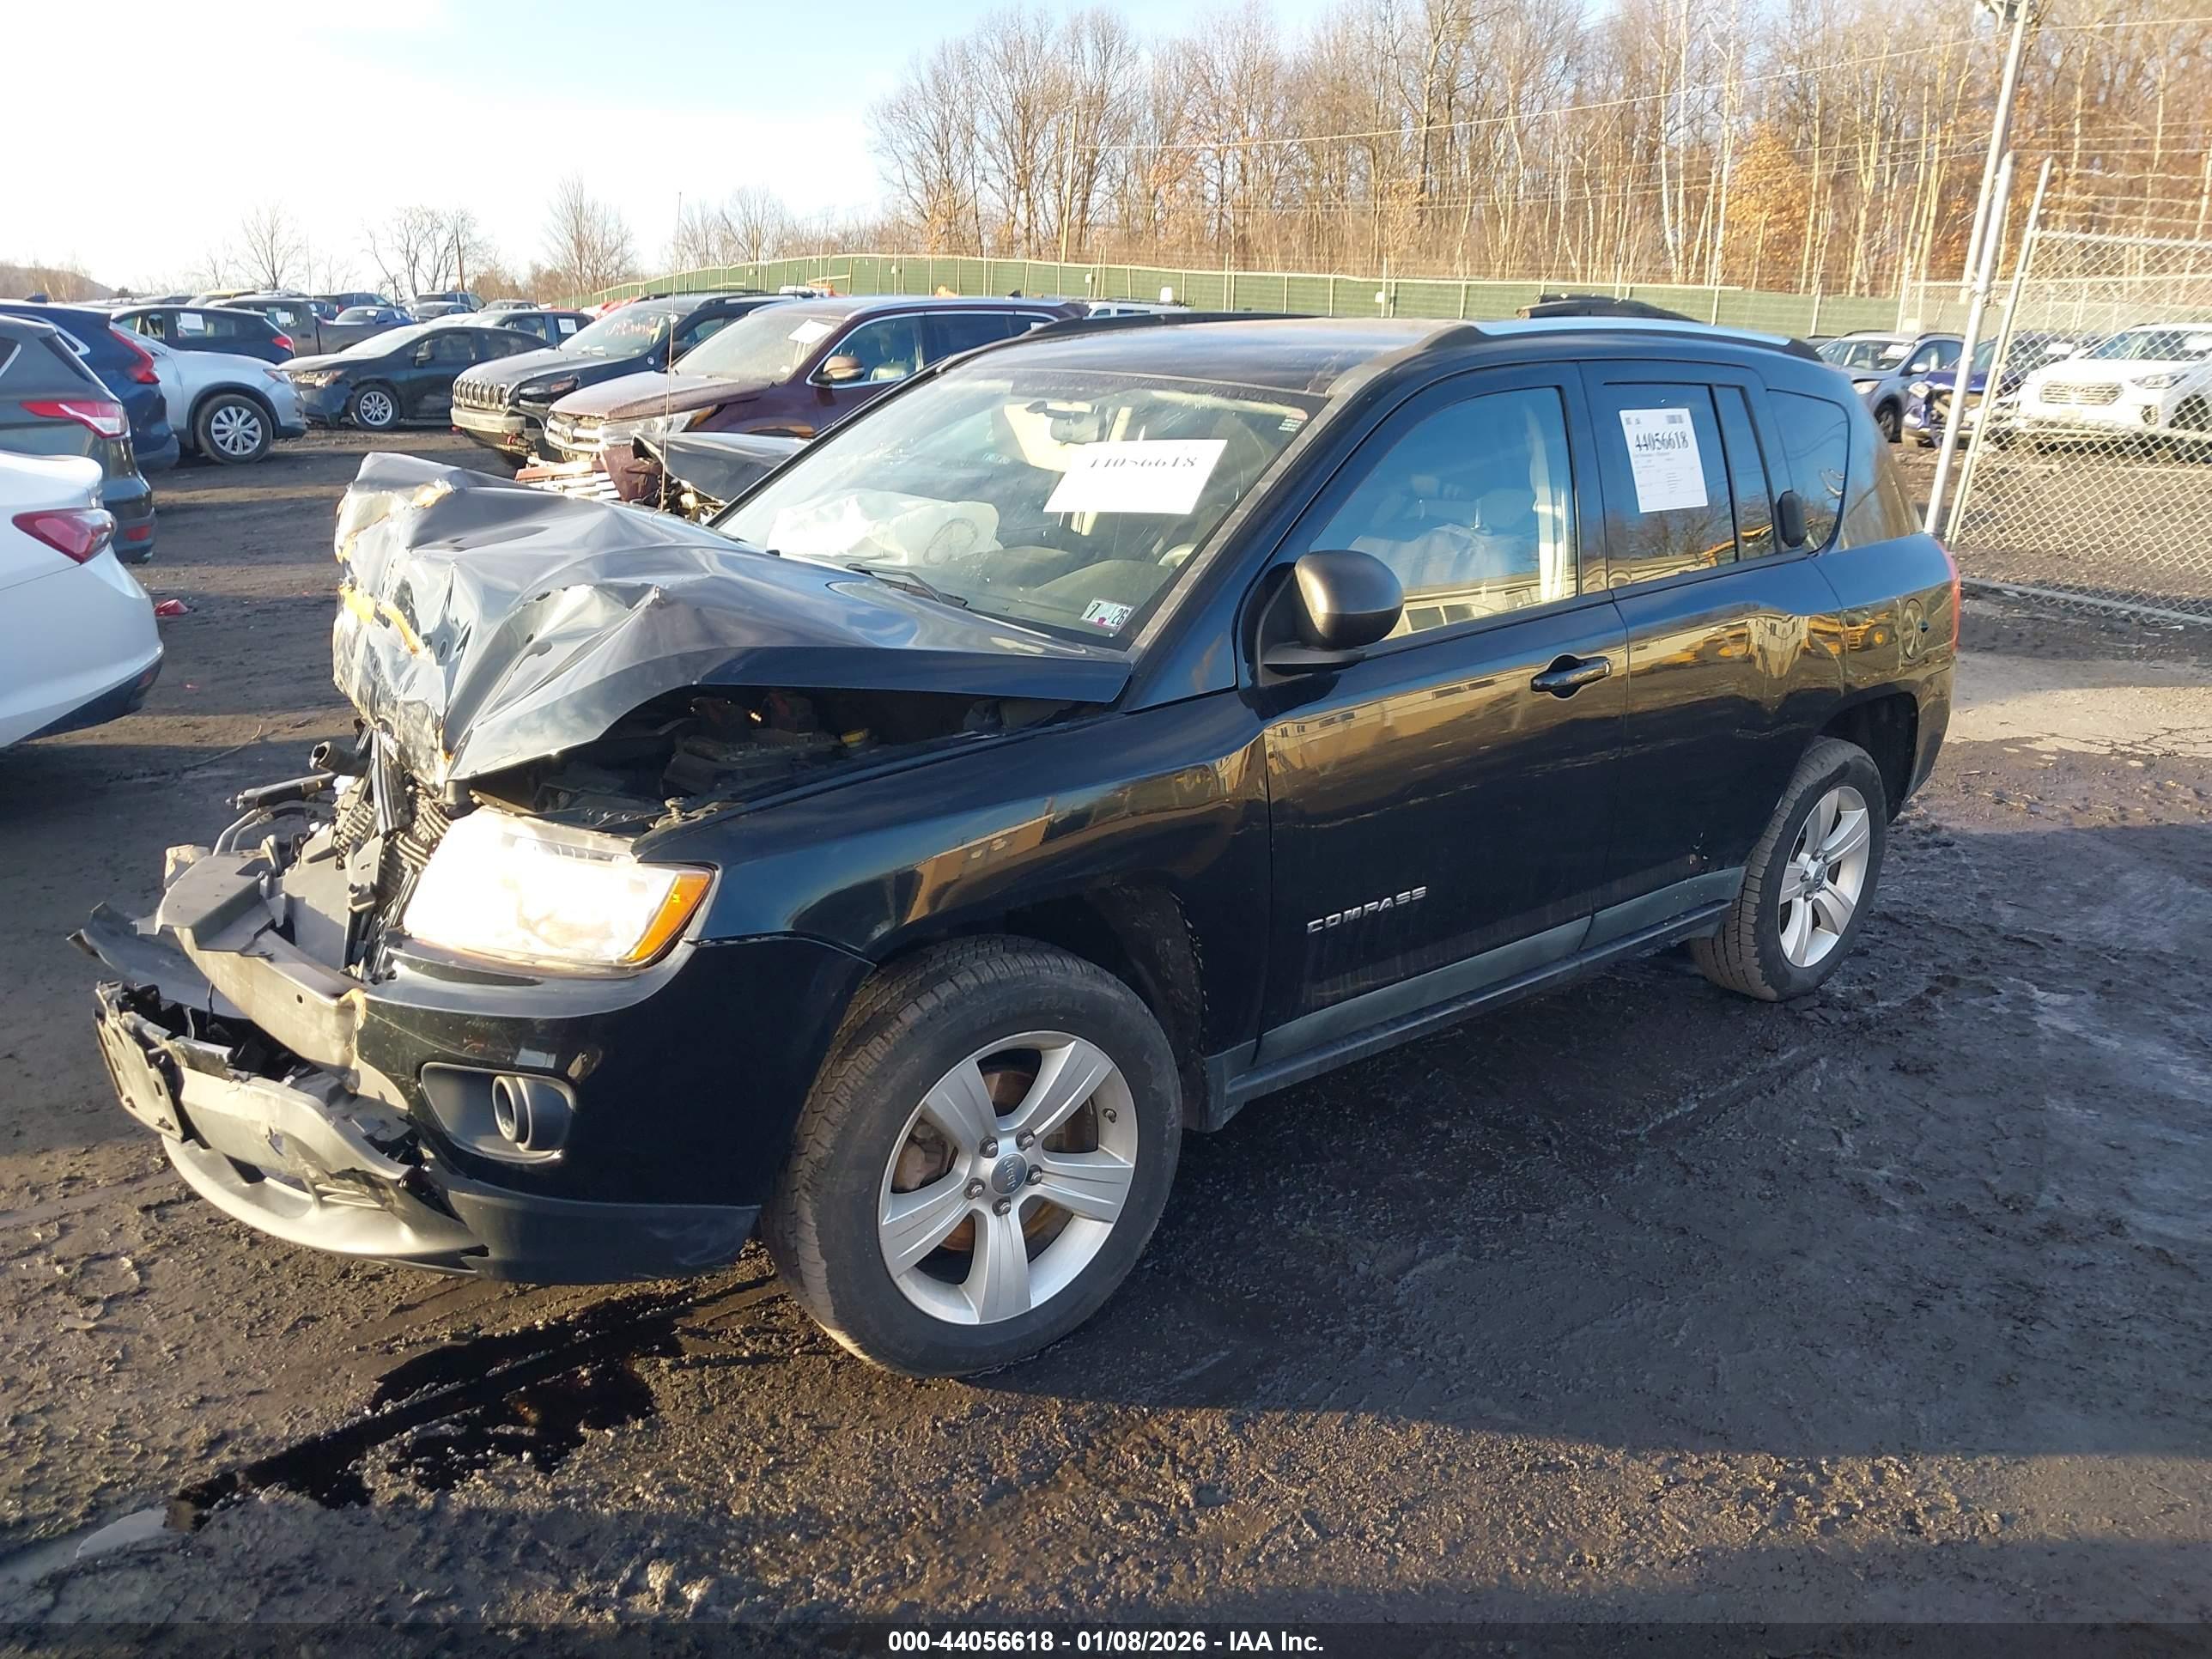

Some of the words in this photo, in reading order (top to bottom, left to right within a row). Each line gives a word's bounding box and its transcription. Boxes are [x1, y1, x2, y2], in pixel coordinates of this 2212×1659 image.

[1635, 430, 1689, 452] 44056618
[1085, 602, 1102, 619] 7
[1111, 607, 1130, 626] 26
[1306, 885, 1428, 934] COMPASS
